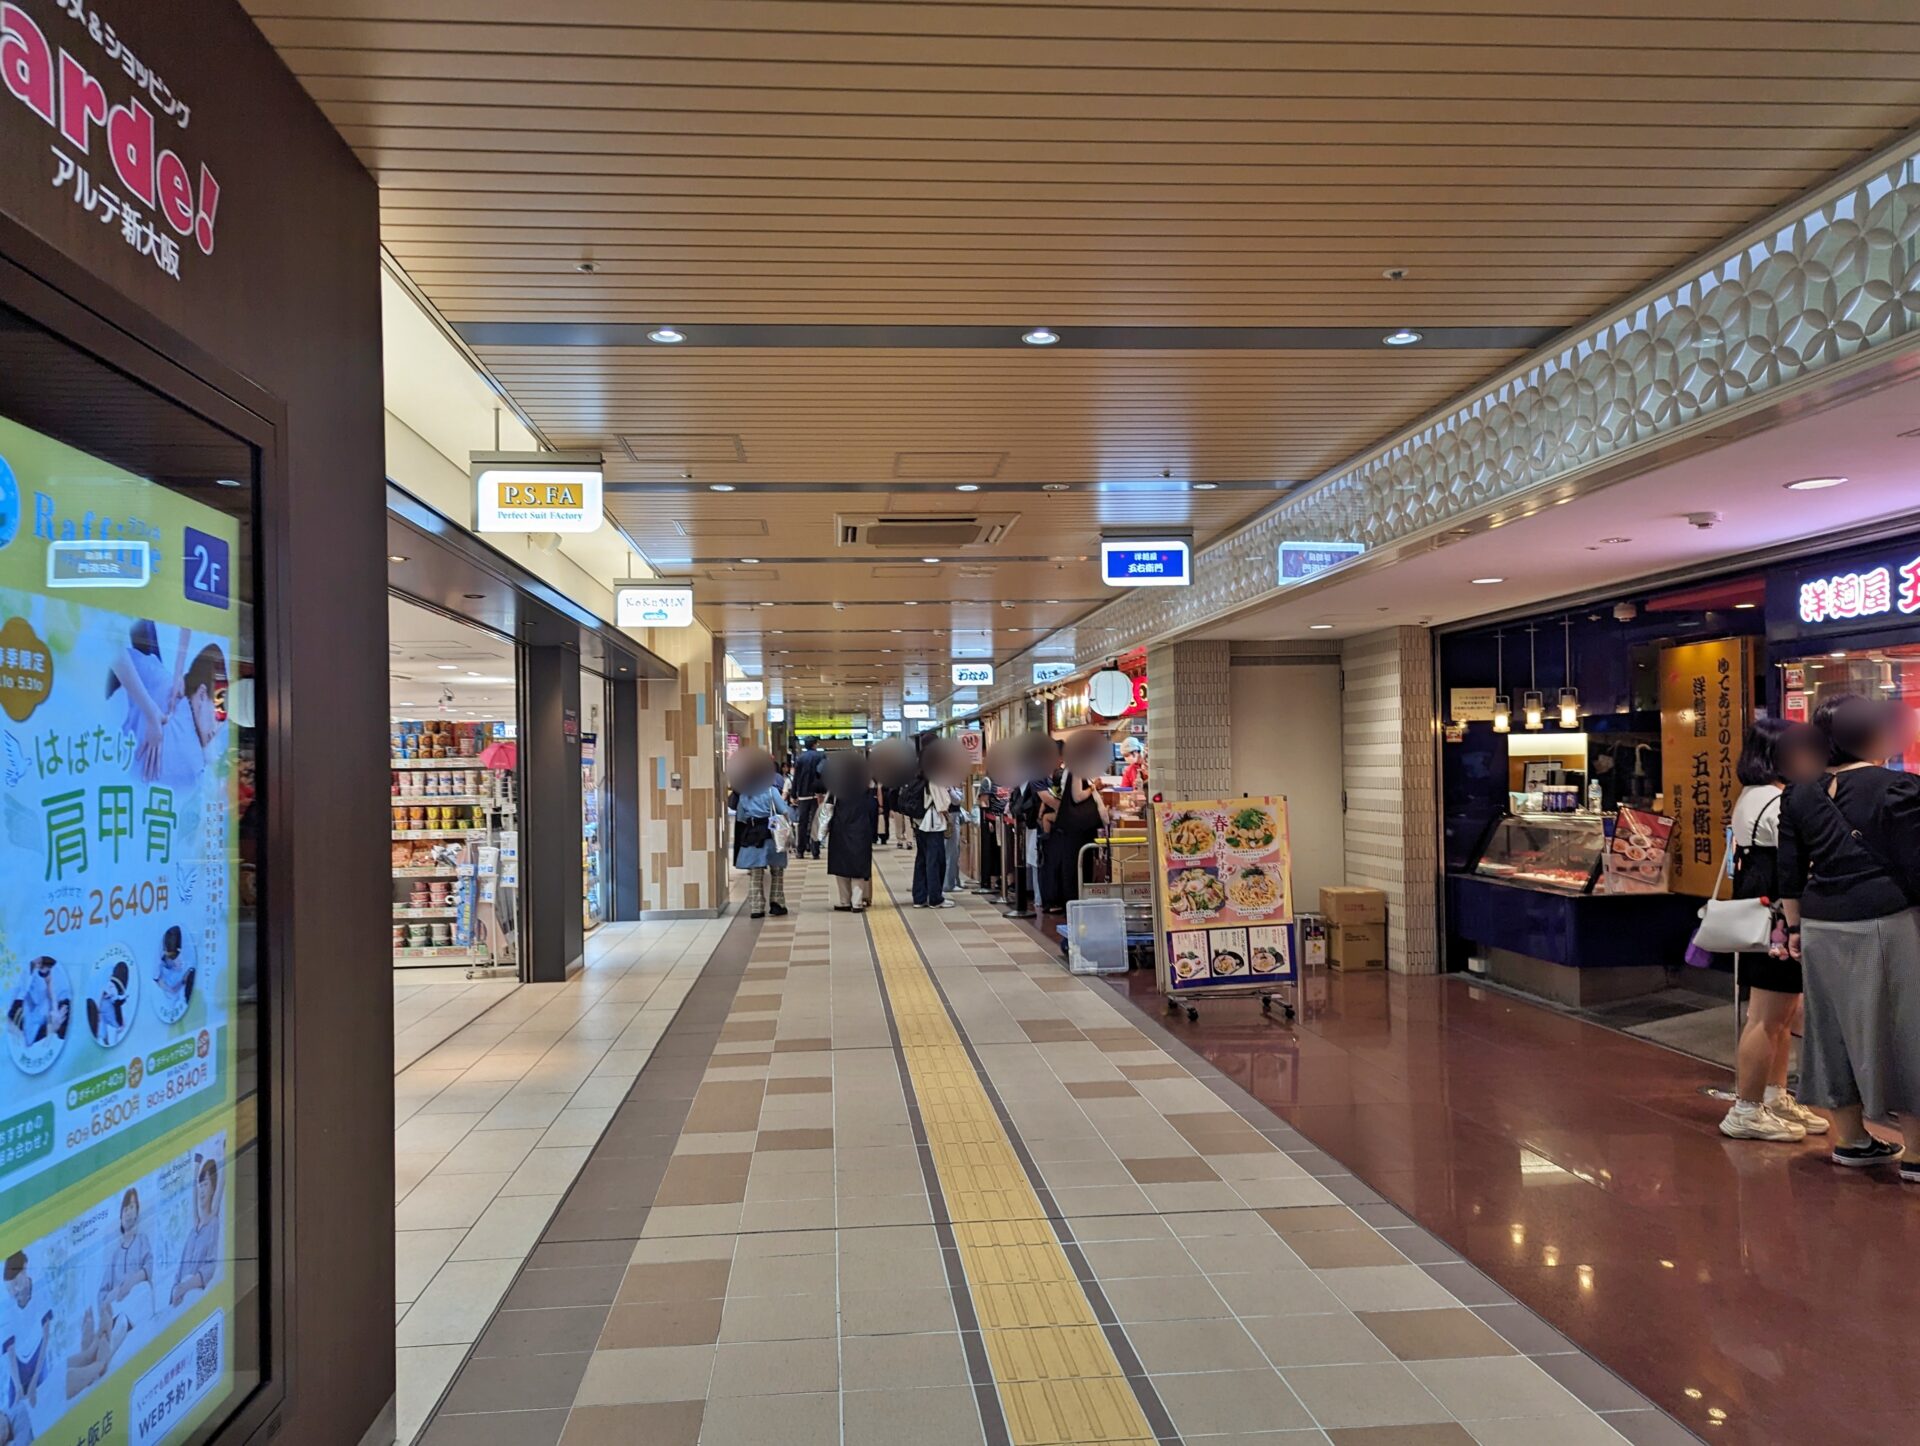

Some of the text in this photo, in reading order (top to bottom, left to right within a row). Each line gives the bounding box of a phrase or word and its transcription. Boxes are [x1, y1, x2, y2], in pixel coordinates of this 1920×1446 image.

[57, 0, 191, 129] メ&ショッピング
[193, 544, 221, 592] 2F
[1799, 566, 1892, 623] 洋麺屋
[34, 724, 136, 780] はばたけ
[41, 785, 177, 882] 肩甲骨
